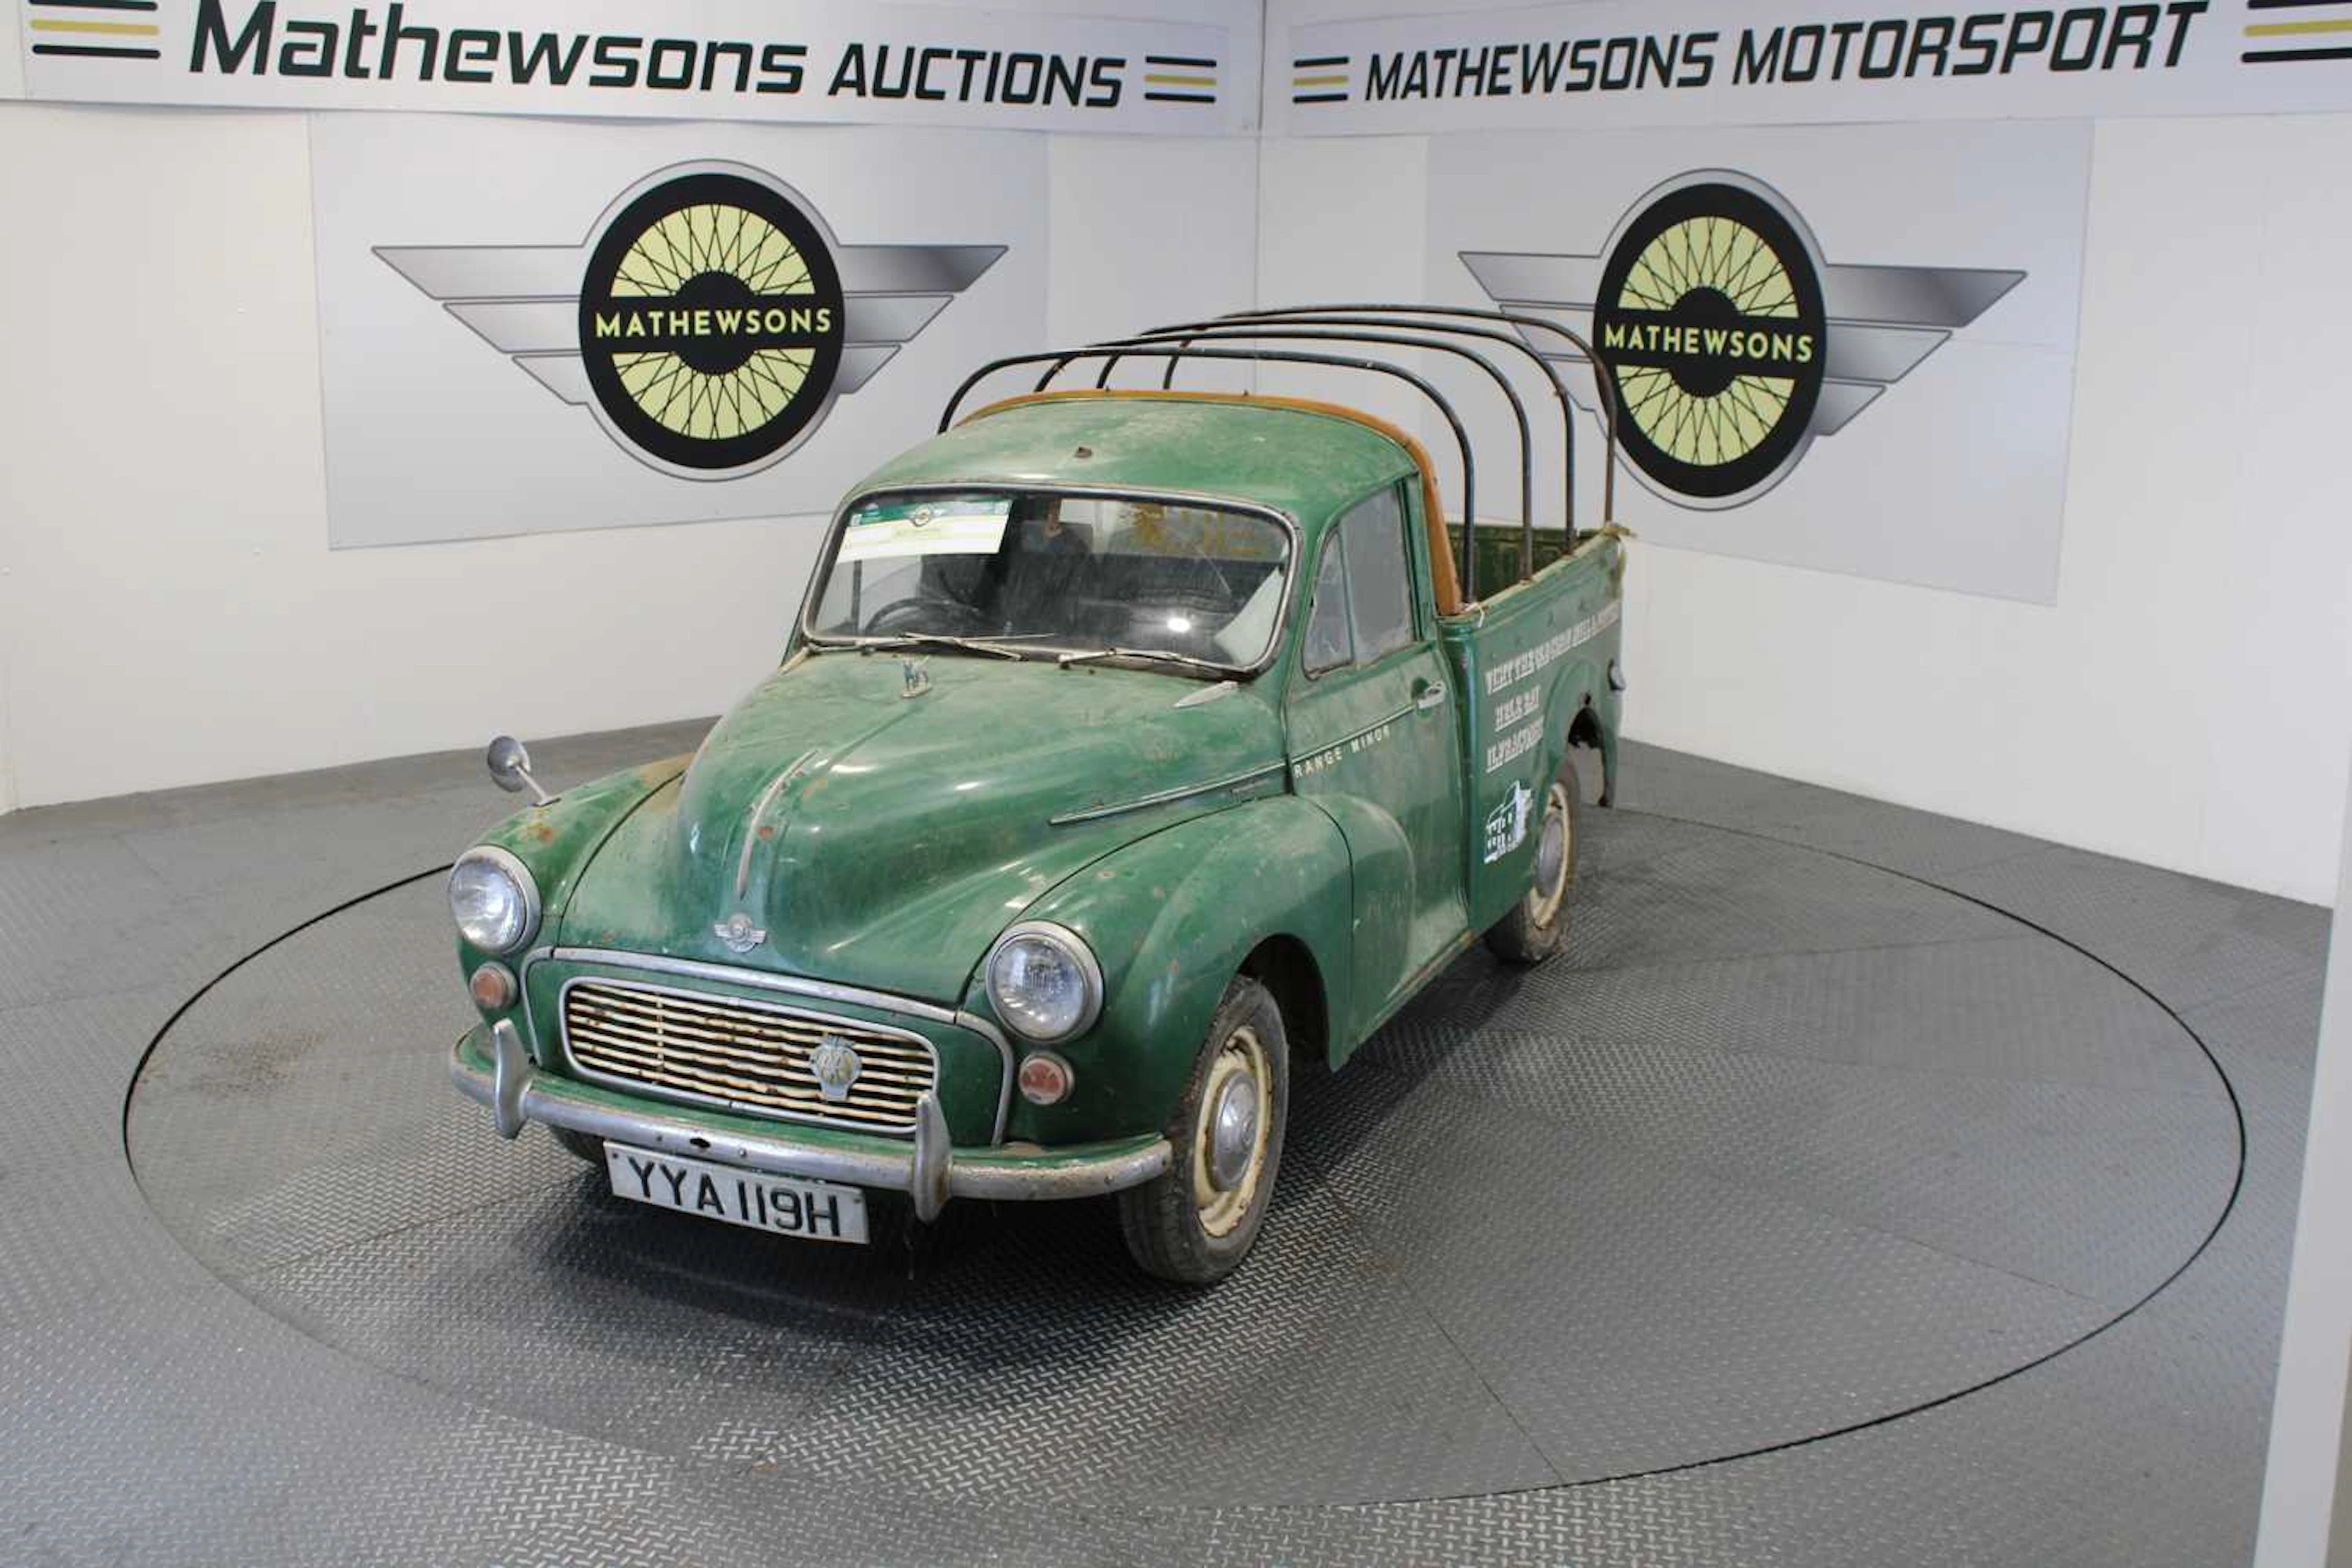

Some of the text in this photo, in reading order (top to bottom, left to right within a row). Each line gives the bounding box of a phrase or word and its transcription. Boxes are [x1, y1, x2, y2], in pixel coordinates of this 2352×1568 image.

[189, 0, 1126, 107] Mathewsons AUCTIONS
[1365, 1, 2207, 101] MATHEWSONS MOTORSPORT
[595, 308, 831, 338] MATHEWSONS
[1604, 323, 1814, 364] MATHEWSONS
[1294, 747, 1343, 778] RANGE
